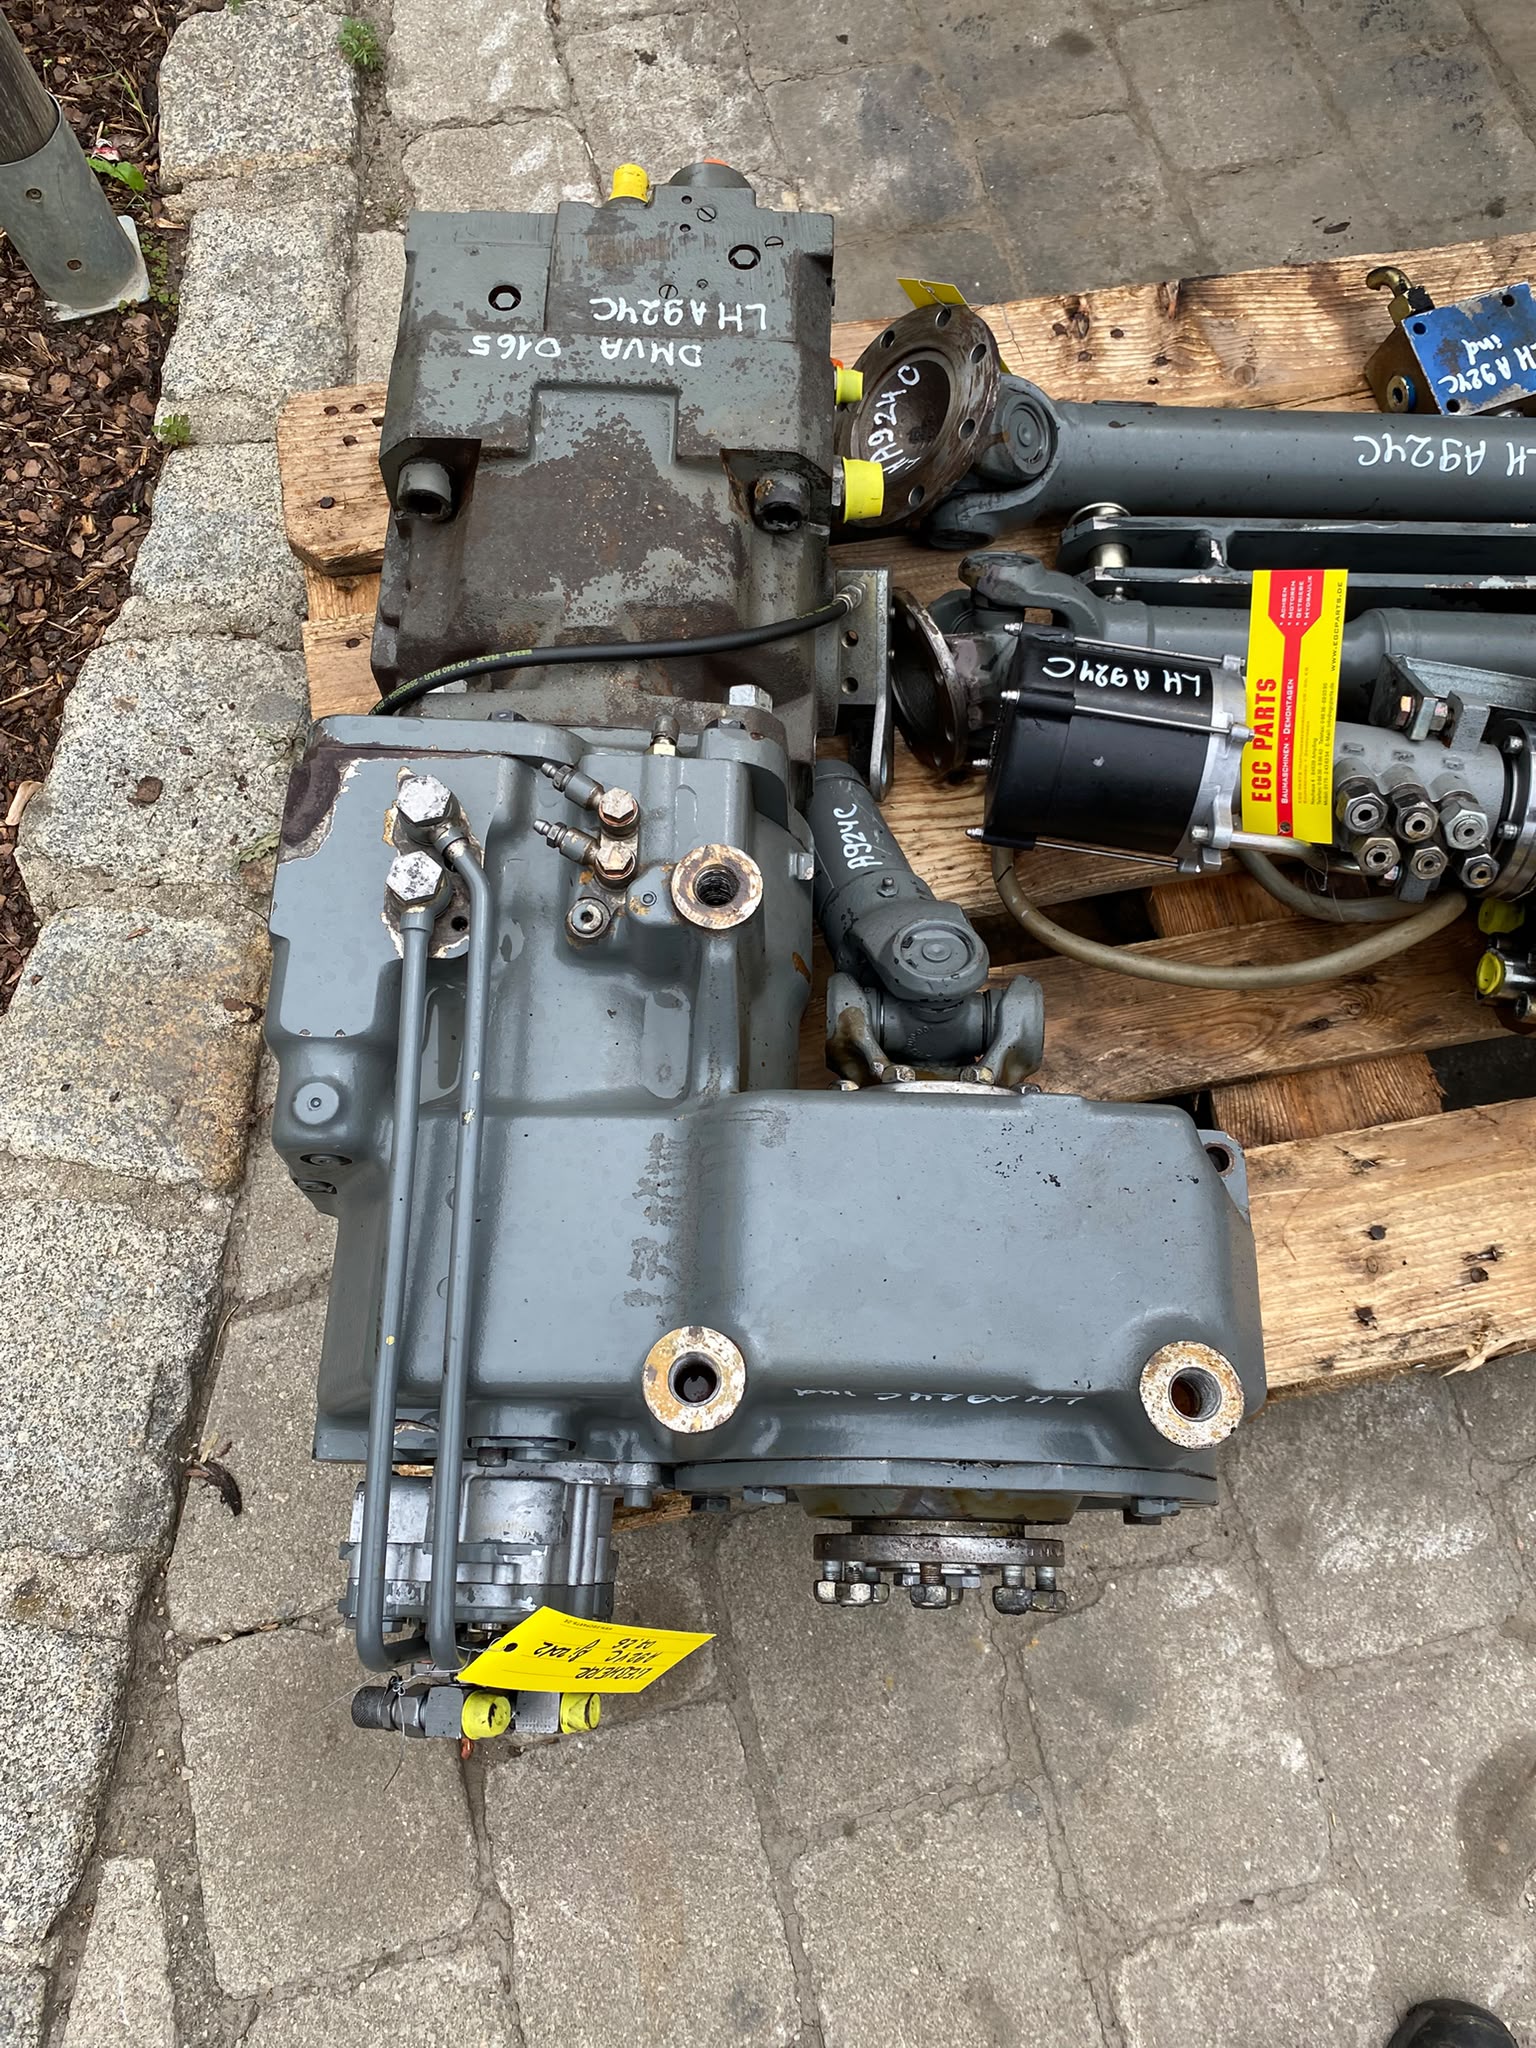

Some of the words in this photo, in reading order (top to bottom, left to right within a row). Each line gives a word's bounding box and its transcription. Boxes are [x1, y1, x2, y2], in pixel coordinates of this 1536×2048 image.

[589, 297, 707, 326] A924C
[718, 303, 766, 332] LH
[600, 336, 702, 367] DMVA
[1460, 333, 1503, 364] ind
[1437, 356, 1511, 394] A924C
[1353, 433, 1486, 476] A924C
[1042, 656, 1150, 691] A924C
[1162, 669, 1201, 697] LH
[1252, 679, 1276, 750] PARTS
[1251, 761, 1272, 802] EGC
